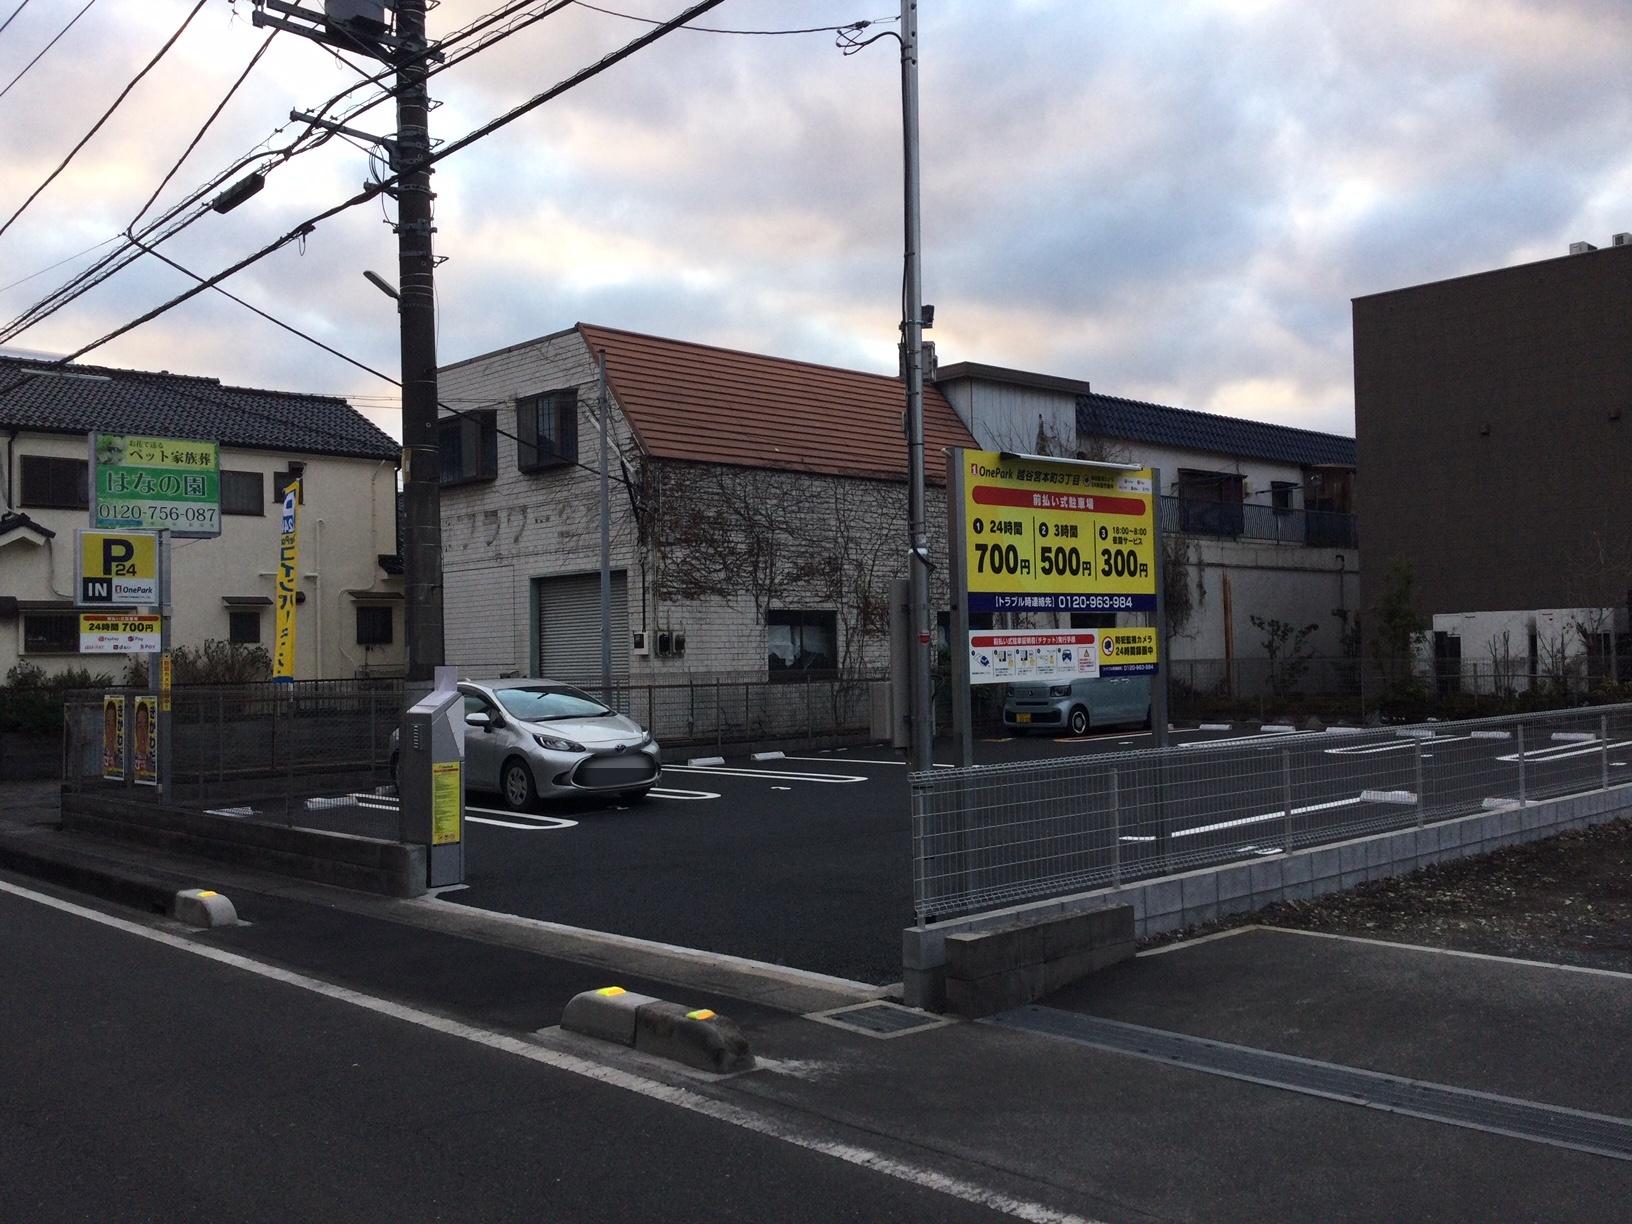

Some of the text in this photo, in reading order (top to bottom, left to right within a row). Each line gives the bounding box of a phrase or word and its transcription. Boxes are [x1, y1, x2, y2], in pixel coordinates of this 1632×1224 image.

[129, 448, 211, 466] ペット家族葬
[979, 466, 1013, 480] OnePark
[107, 470, 207, 497] はなの園
[1032, 493, 1094, 510] 前払い式駐車場
[99, 504, 216, 523] 0120-756-087
[989, 520, 1023, 535] 24時間
[1053, 524, 1078, 538] 3時間
[103, 538, 134, 576] P
[975, 543, 1031, 575] 700円
[1040, 546, 1092, 577] 500円
[1101, 548, 1148, 578] 300円
[115, 563, 137, 577] 24
[88, 582, 107, 597] IN
[123, 586, 153, 594] OnePark
[1058, 596, 1133, 608] 0120-963-984
[121, 622, 154, 632] 700円
